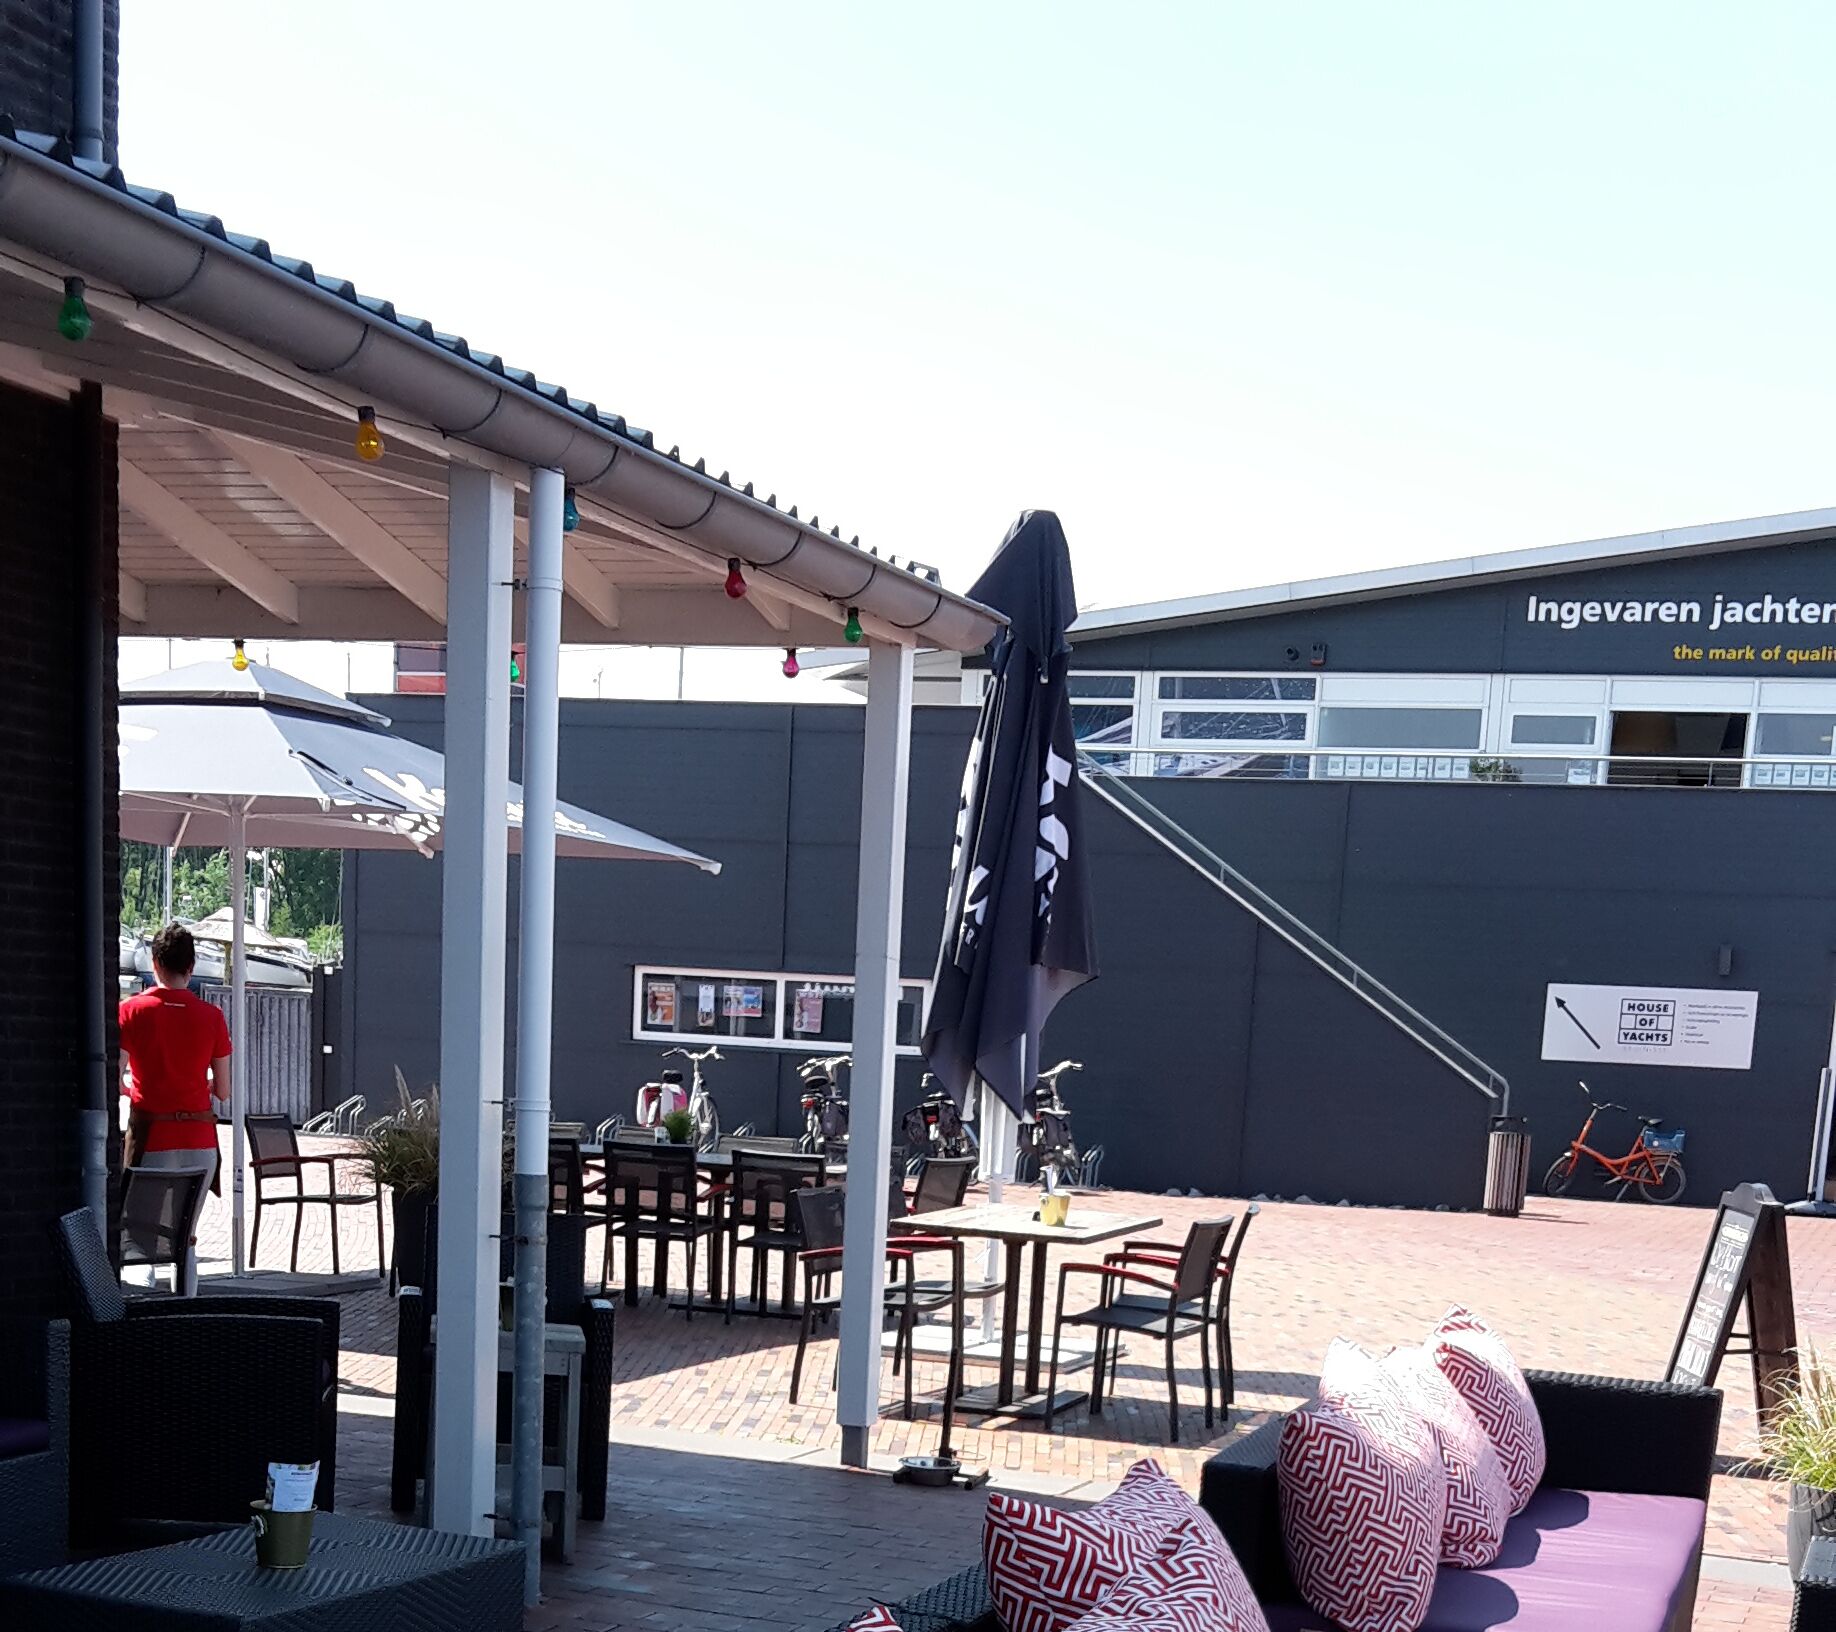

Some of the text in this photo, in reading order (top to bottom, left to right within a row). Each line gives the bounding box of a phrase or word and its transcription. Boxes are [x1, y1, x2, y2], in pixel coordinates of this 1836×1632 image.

[1527, 595, 1700, 628] Ingevaren
[1673, 644, 1836, 664] the mark of quali
[1627, 1002, 1669, 1013] HOUSE
[1639, 1018, 1655, 1027] OF
[1623, 1031, 1668, 1042] YACHTS
